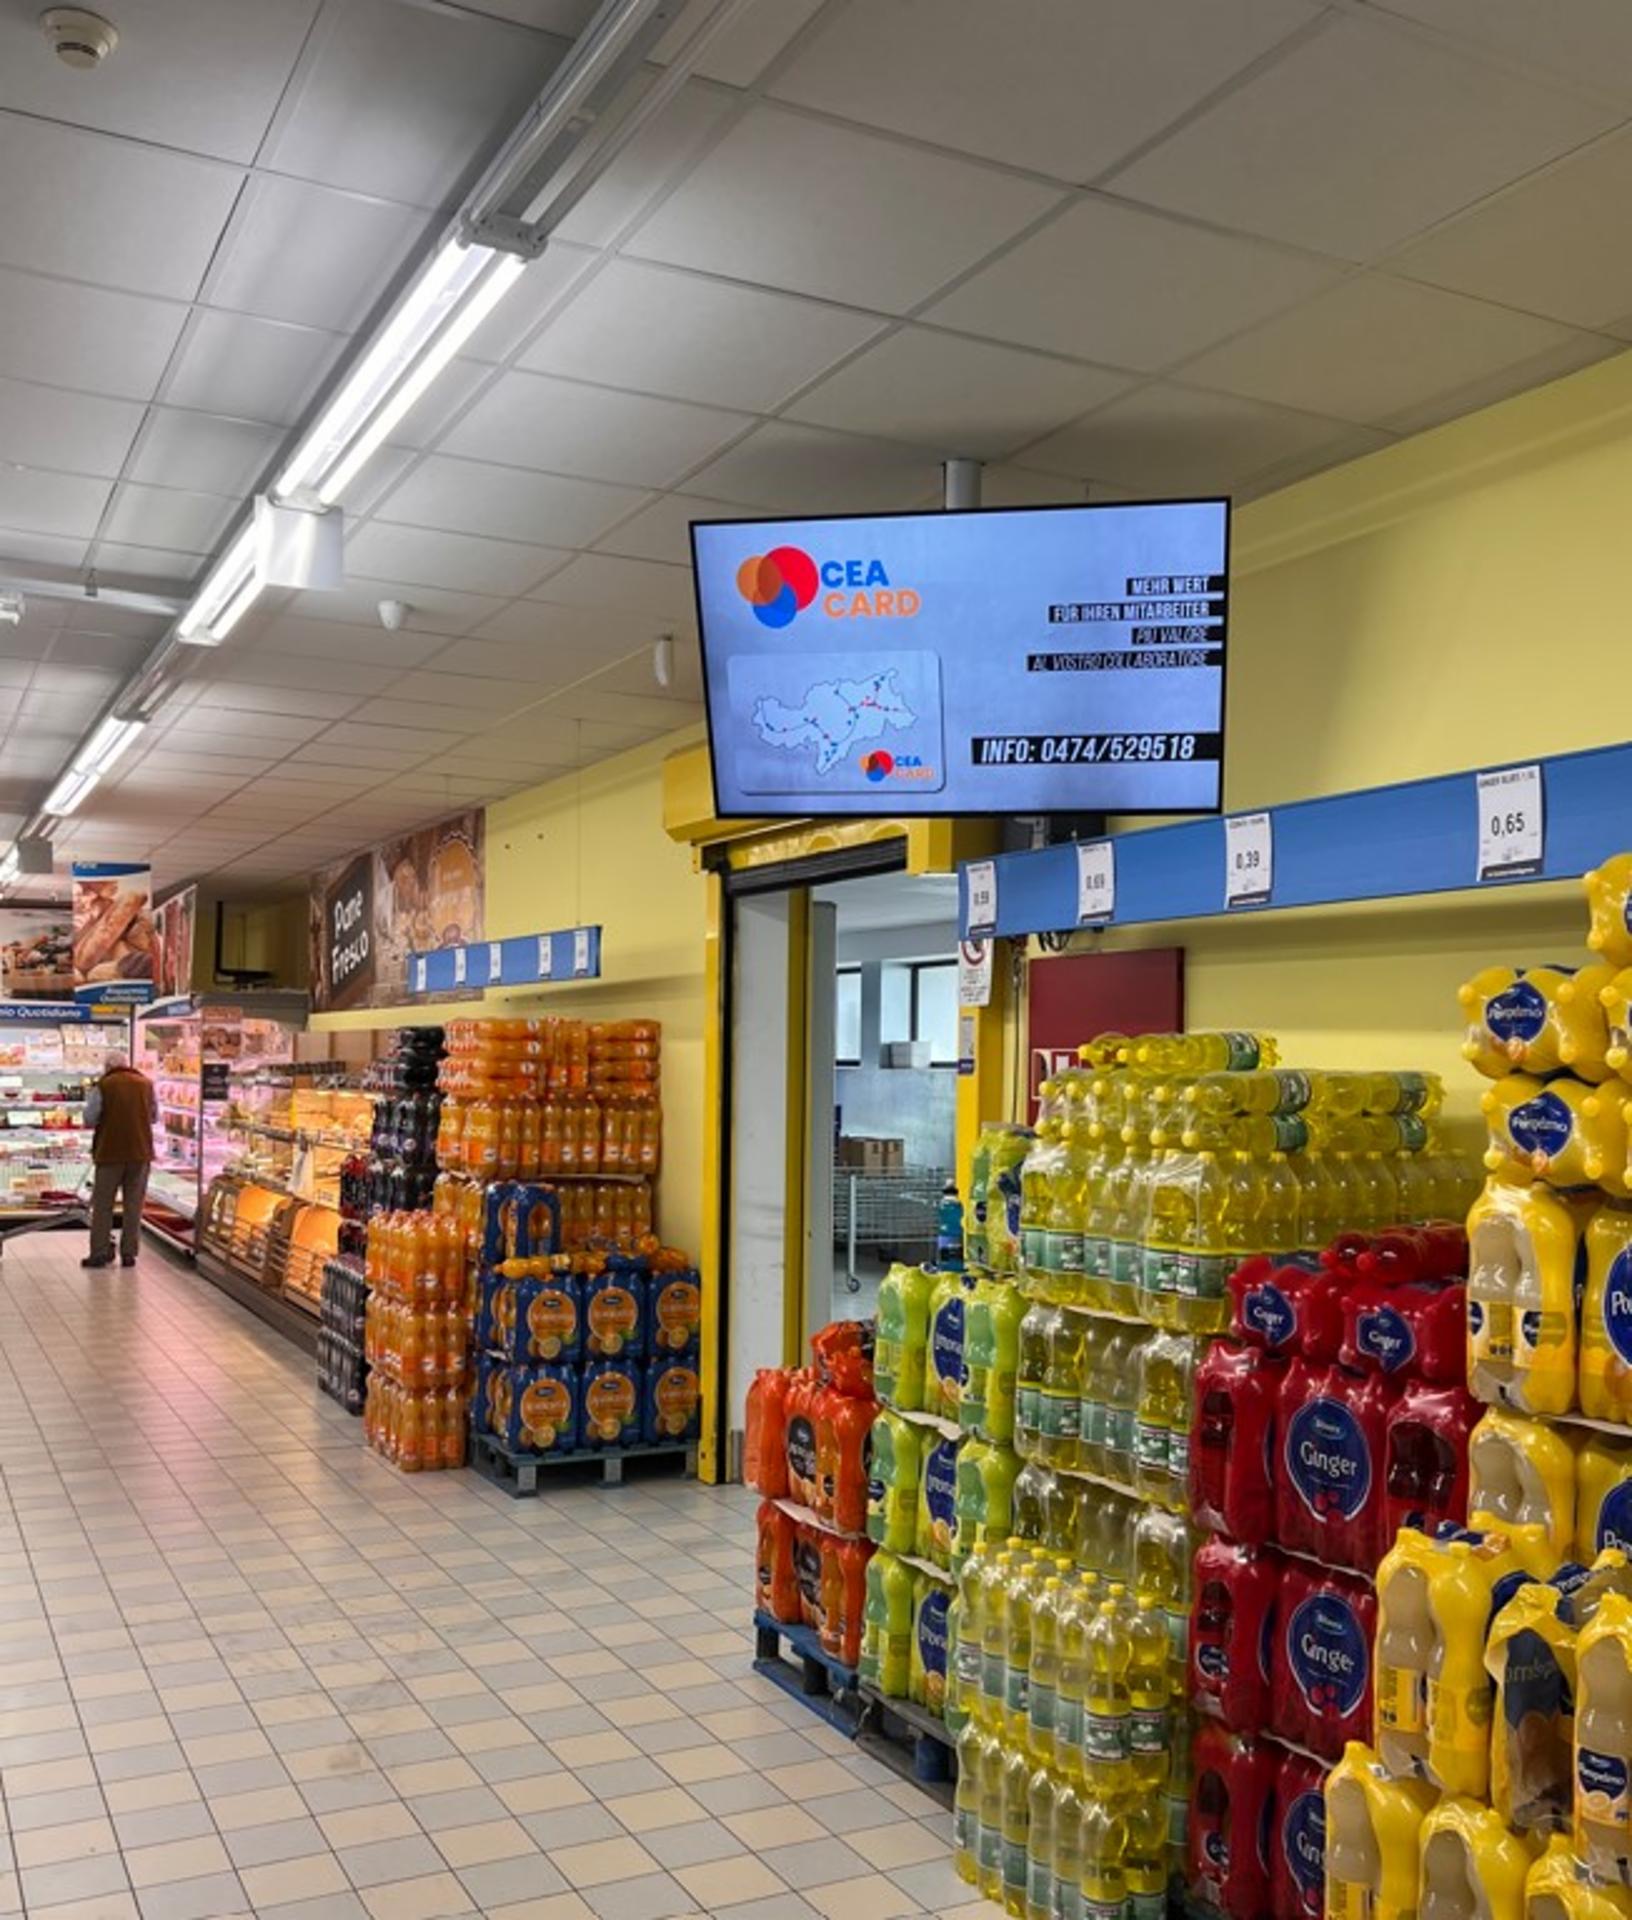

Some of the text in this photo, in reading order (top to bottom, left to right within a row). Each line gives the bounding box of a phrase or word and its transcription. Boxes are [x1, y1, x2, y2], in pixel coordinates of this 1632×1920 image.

[820, 559, 890, 588] CEA
[1131, 576, 1210, 595] MEHR WERT
[823, 589, 922, 619] CARD
[1123, 602, 1210, 620] MITARBEITER
[980, 735, 1195, 763] INFO: 0474/529518
[1491, 812, 1526, 837] 0,65
[1236, 850, 1259, 870] 0,39
[332, 929, 369, 985] Fresco
[17, 1005, 82, 1019] Quotidiano
[1300, 1440, 1358, 1479] Ginger
